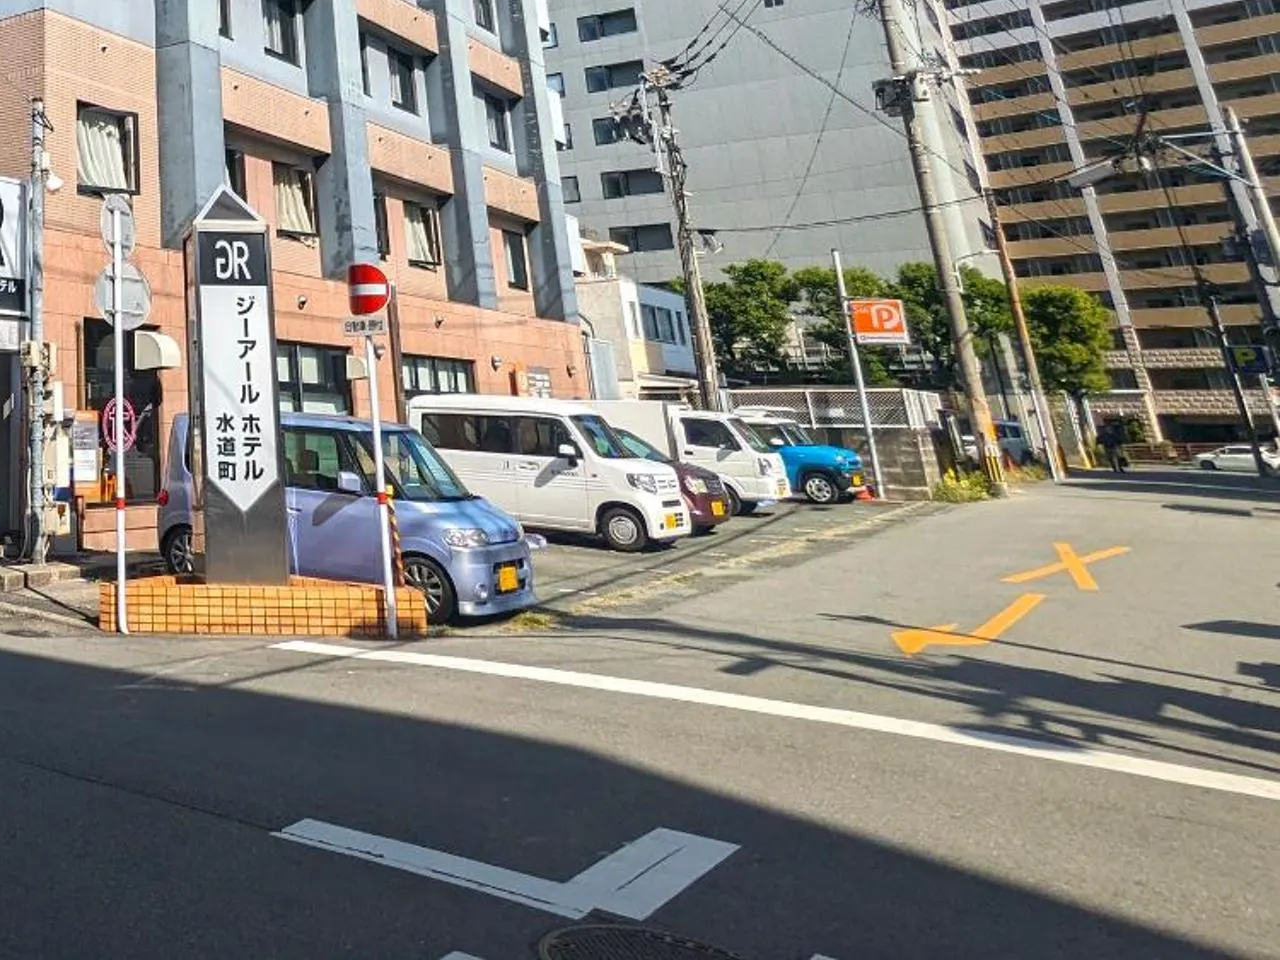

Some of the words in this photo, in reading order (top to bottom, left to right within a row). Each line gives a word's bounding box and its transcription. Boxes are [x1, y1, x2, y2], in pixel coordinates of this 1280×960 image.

[214, 240, 251, 280] GR
[216, 413, 237, 481] 水道町
